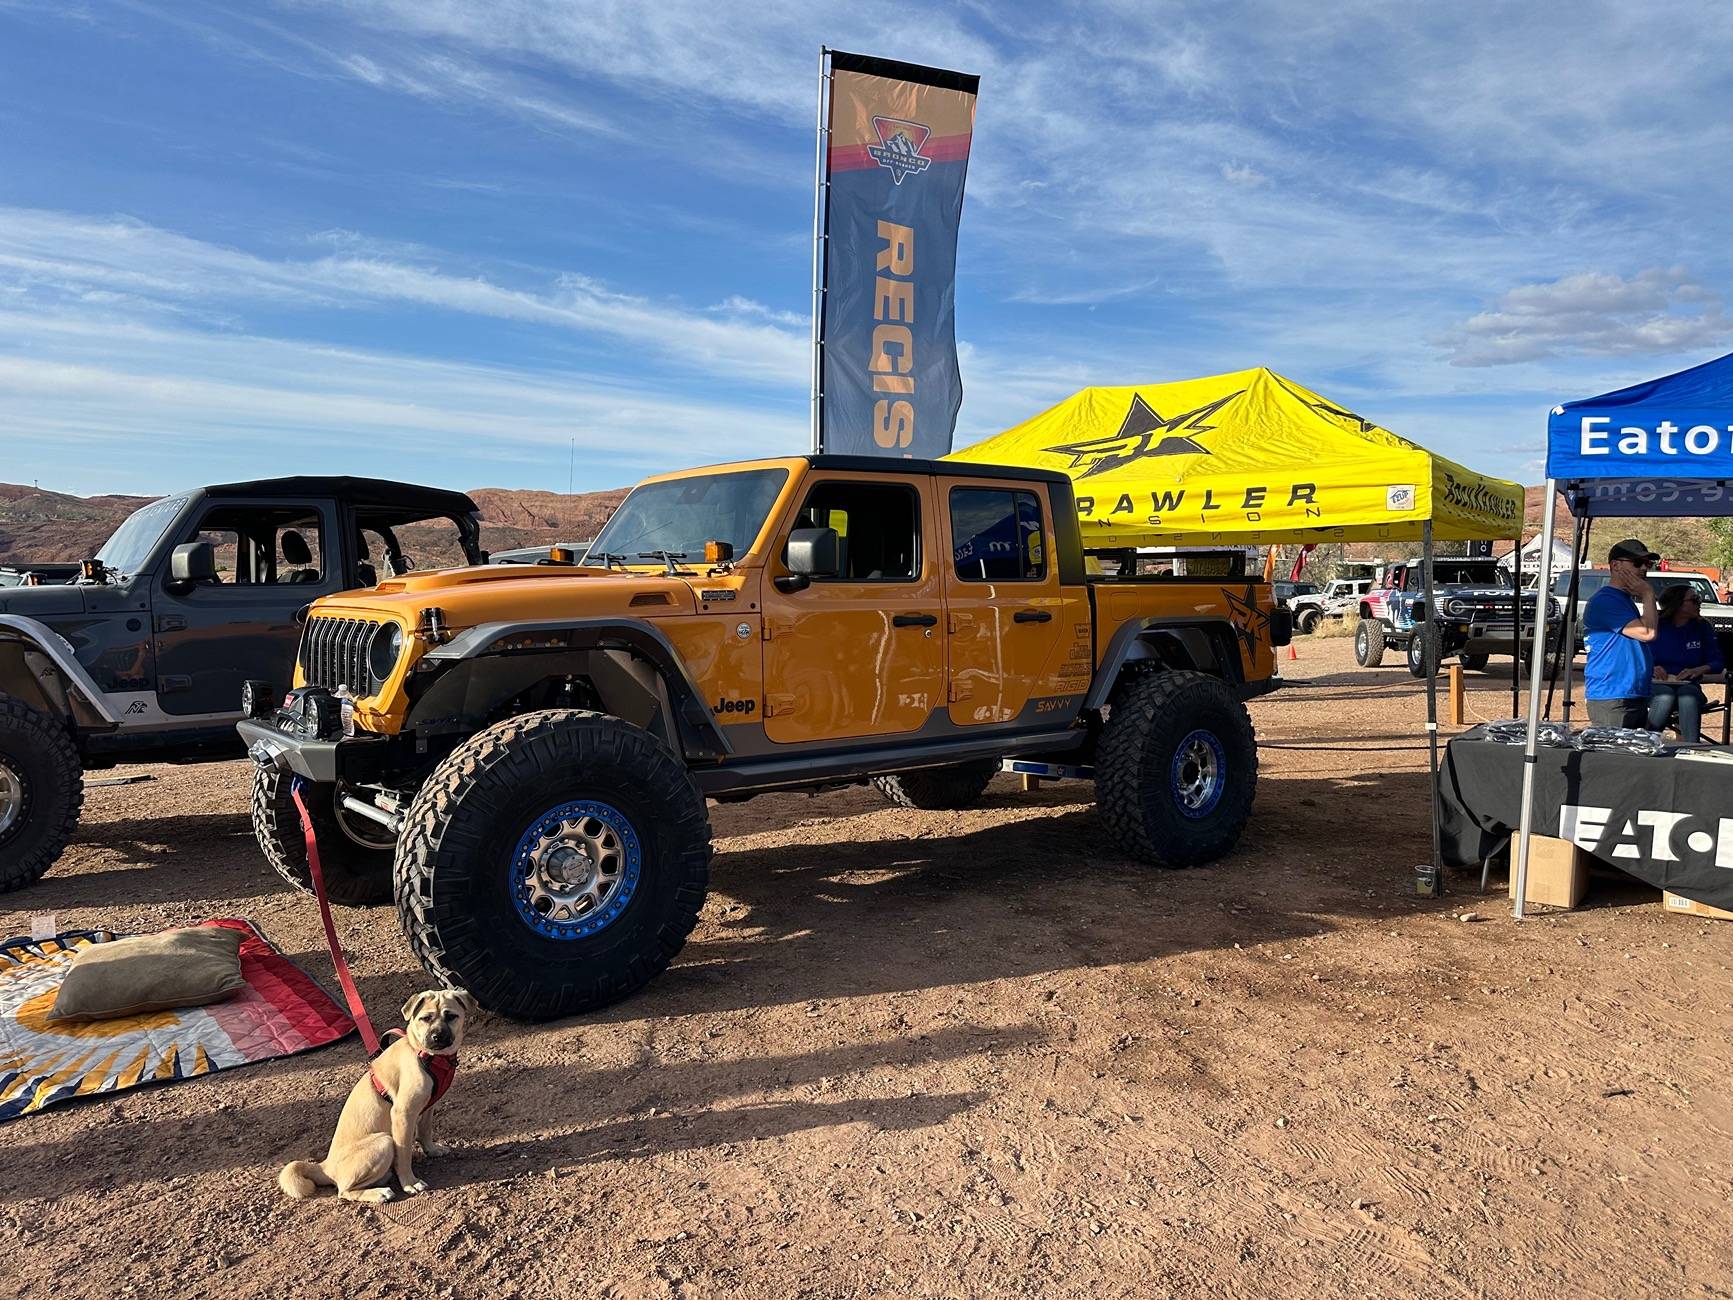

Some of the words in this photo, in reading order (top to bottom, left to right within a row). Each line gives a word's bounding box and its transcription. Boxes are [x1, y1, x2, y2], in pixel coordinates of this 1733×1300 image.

[873, 149, 925, 167] BRONCO
[868, 218, 915, 460] REGIS
[1580, 416, 1733, 455] Eato
[713, 697, 755, 715] Jeep
[1035, 699, 1072, 713] SAVVY
